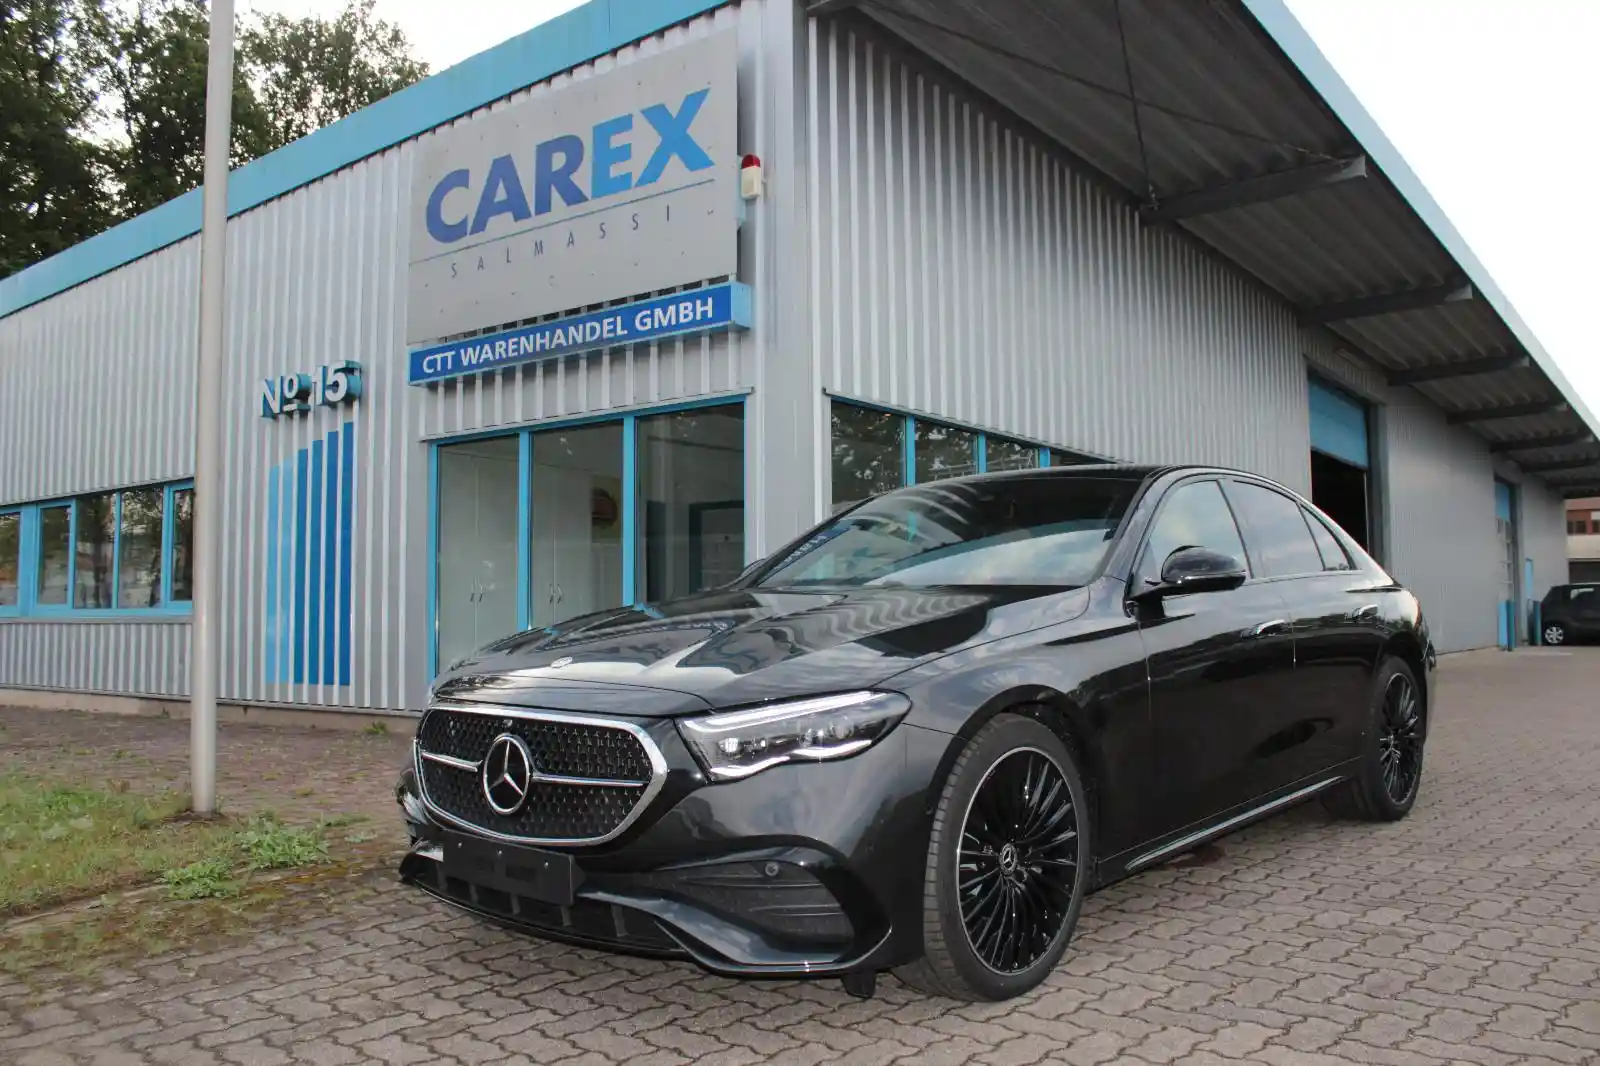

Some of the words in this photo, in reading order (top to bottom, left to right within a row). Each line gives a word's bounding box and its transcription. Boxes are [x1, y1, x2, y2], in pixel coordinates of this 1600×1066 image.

[425, 88, 716, 244] CAREX
[450, 204, 676, 279] SALMASSI
[422, 350, 456, 375] CTT
[460, 316, 628, 368] WARENHANDEL
[634, 296, 714, 332] GMBH
[312, 360, 354, 407] 15
